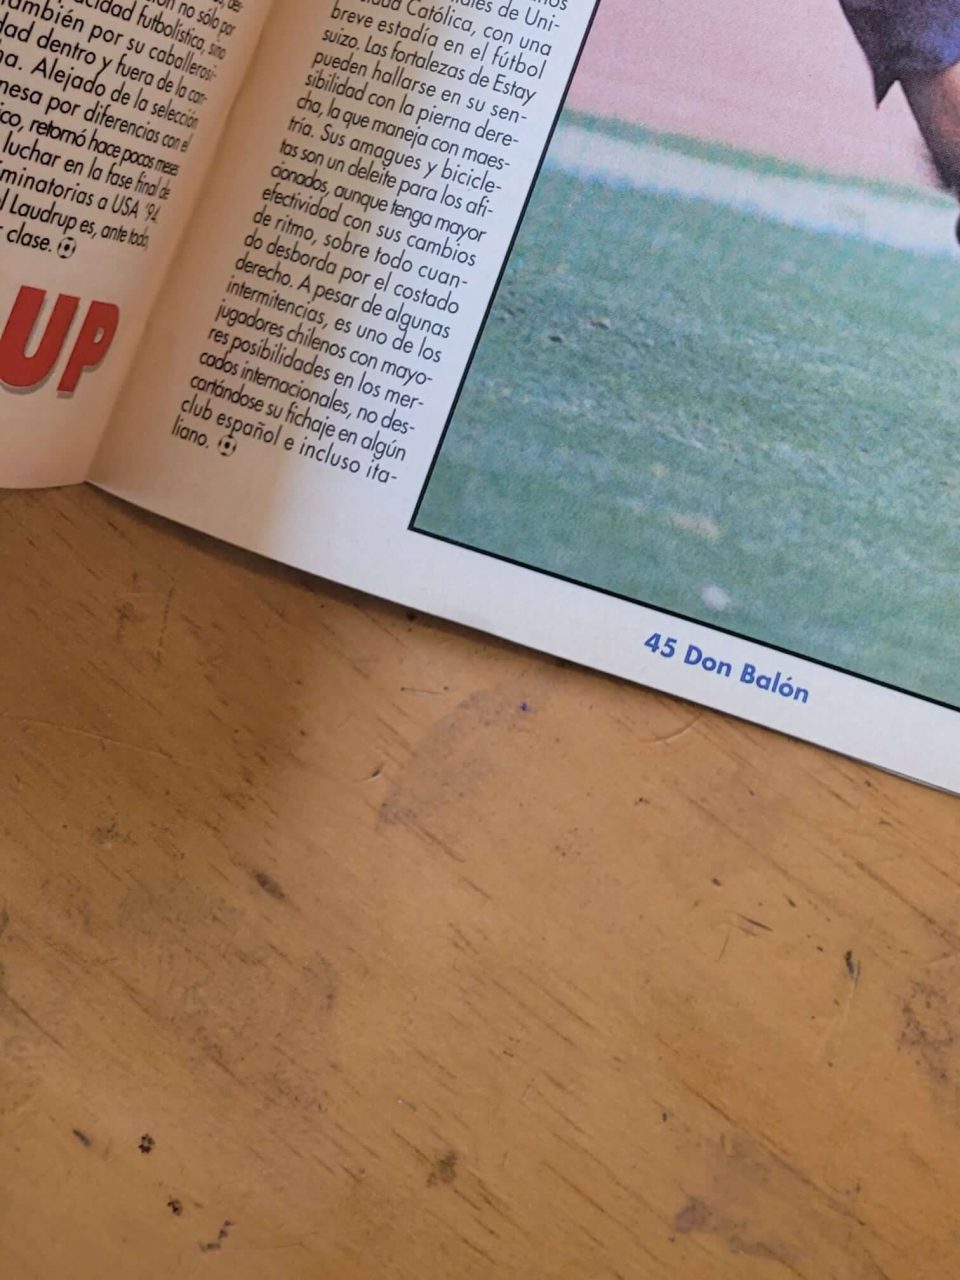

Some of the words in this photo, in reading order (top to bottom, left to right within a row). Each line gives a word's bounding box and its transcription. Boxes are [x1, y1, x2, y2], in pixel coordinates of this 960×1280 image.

[86, 23, 124, 46] por
[125, 37, 146, 55] su
[329, 0, 373, 28] breve
[376, 19, 439, 47] estadía
[443, 38, 464, 55] en
[469, 41, 489, 61] el
[491, 44, 547, 79] fútbol
[310, 51, 368, 77] pueden
[370, 61, 436, 97] hallarse
[440, 88, 461, 105] en
[465, 96, 486, 112] su
[489, 104, 526, 123] sen-
[234, 251, 293, 288] derecho.
[295, 273, 311, 293] A
[310, 283, 360, 308] pesar
[360, 292, 382, 316] de
[384, 302, 450, 339] algunas
[169, 414, 209, 449] liano.
[180, 393, 213, 421] club
[215, 412, 283, 446] español
[282, 436, 294, 451] e
[298, 435, 360, 473] incluso
[365, 458, 397, 483] ita-
[644, 632, 678, 659] 45
[683, 644, 732, 678] Don
[739, 662, 810, 704] Balón
